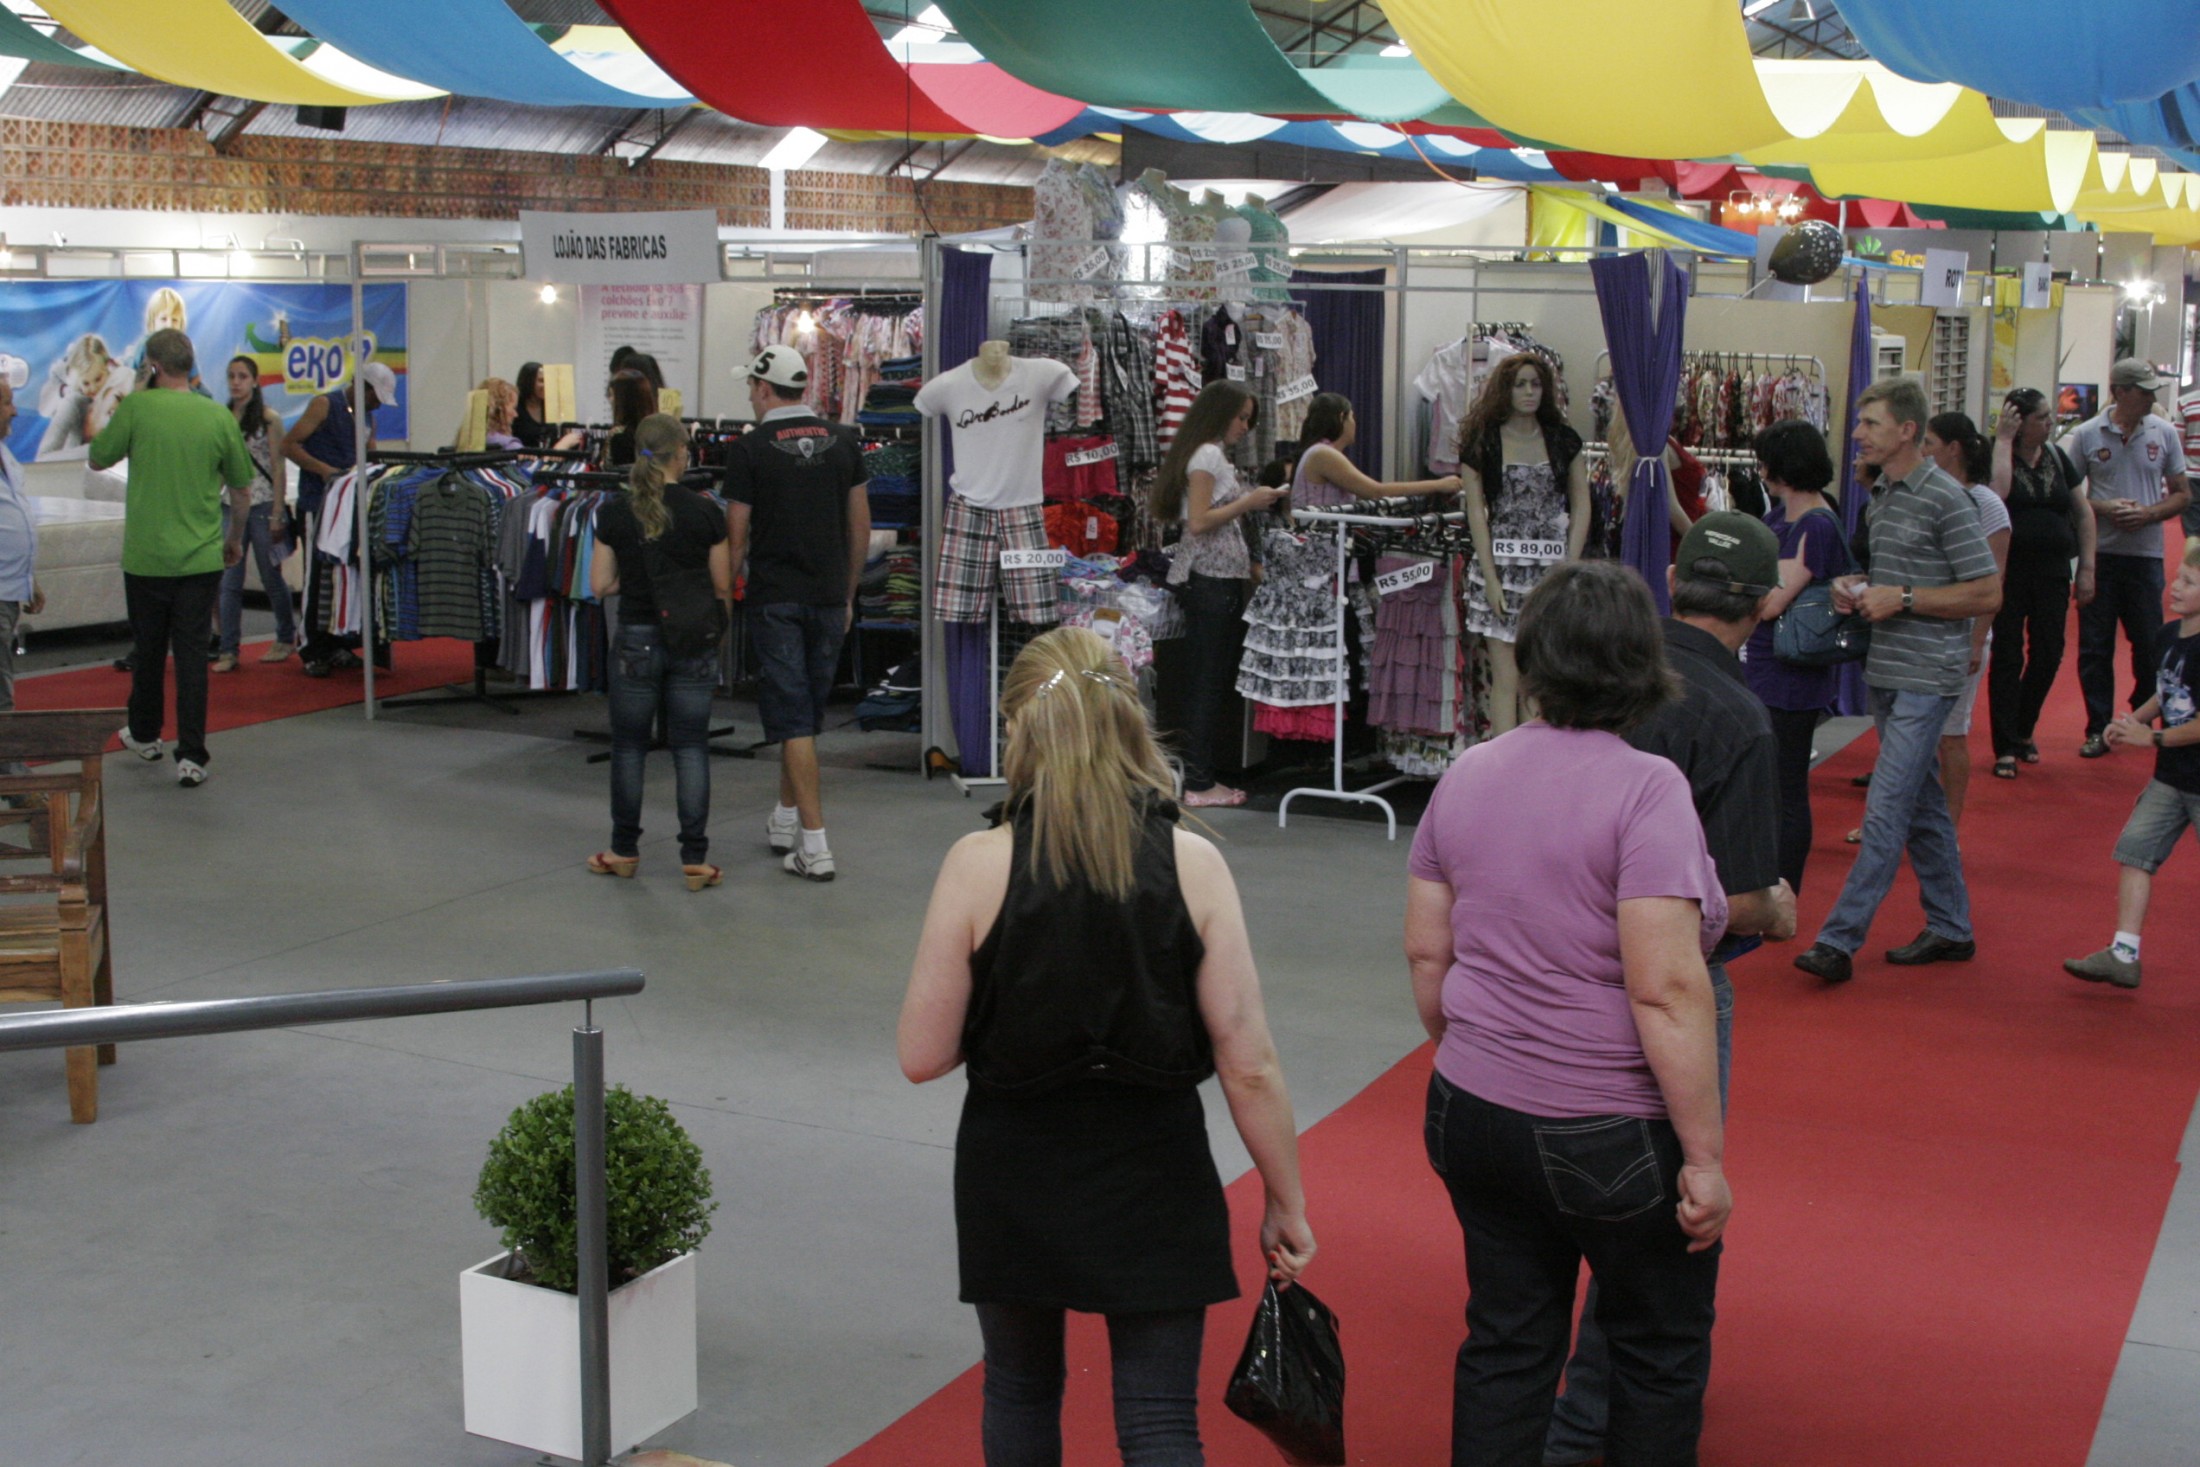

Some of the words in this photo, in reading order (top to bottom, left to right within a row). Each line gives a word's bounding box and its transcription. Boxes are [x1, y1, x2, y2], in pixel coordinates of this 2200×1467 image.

[586, 236, 606, 260] DAS
[609, 235, 667, 260] FABRICAS
[1216, 262, 1230, 272] R$
[1232, 255, 1256, 269] 25,00
[1273, 260, 1293, 275] 25,00
[601, 294, 643, 305] colchões
[601, 310, 639, 321] previne
[642, 310, 648, 319] e
[288, 344, 343, 389] eko
[753, 351, 776, 375] 5
[1287, 378, 1314, 397] 35,00
[776, 426, 829, 441] AUTHENTIC
[1066, 453, 1081, 464] R$
[1085, 444, 1118, 461] 10,00
[1494, 541, 1515, 554] R$
[1520, 543, 1563, 557] 89,00
[1003, 553, 1022, 565] R$
[1026, 553, 1064, 565] 20,00
[1378, 575, 1398, 589] R$
[1401, 565, 1430, 583] 55,00
